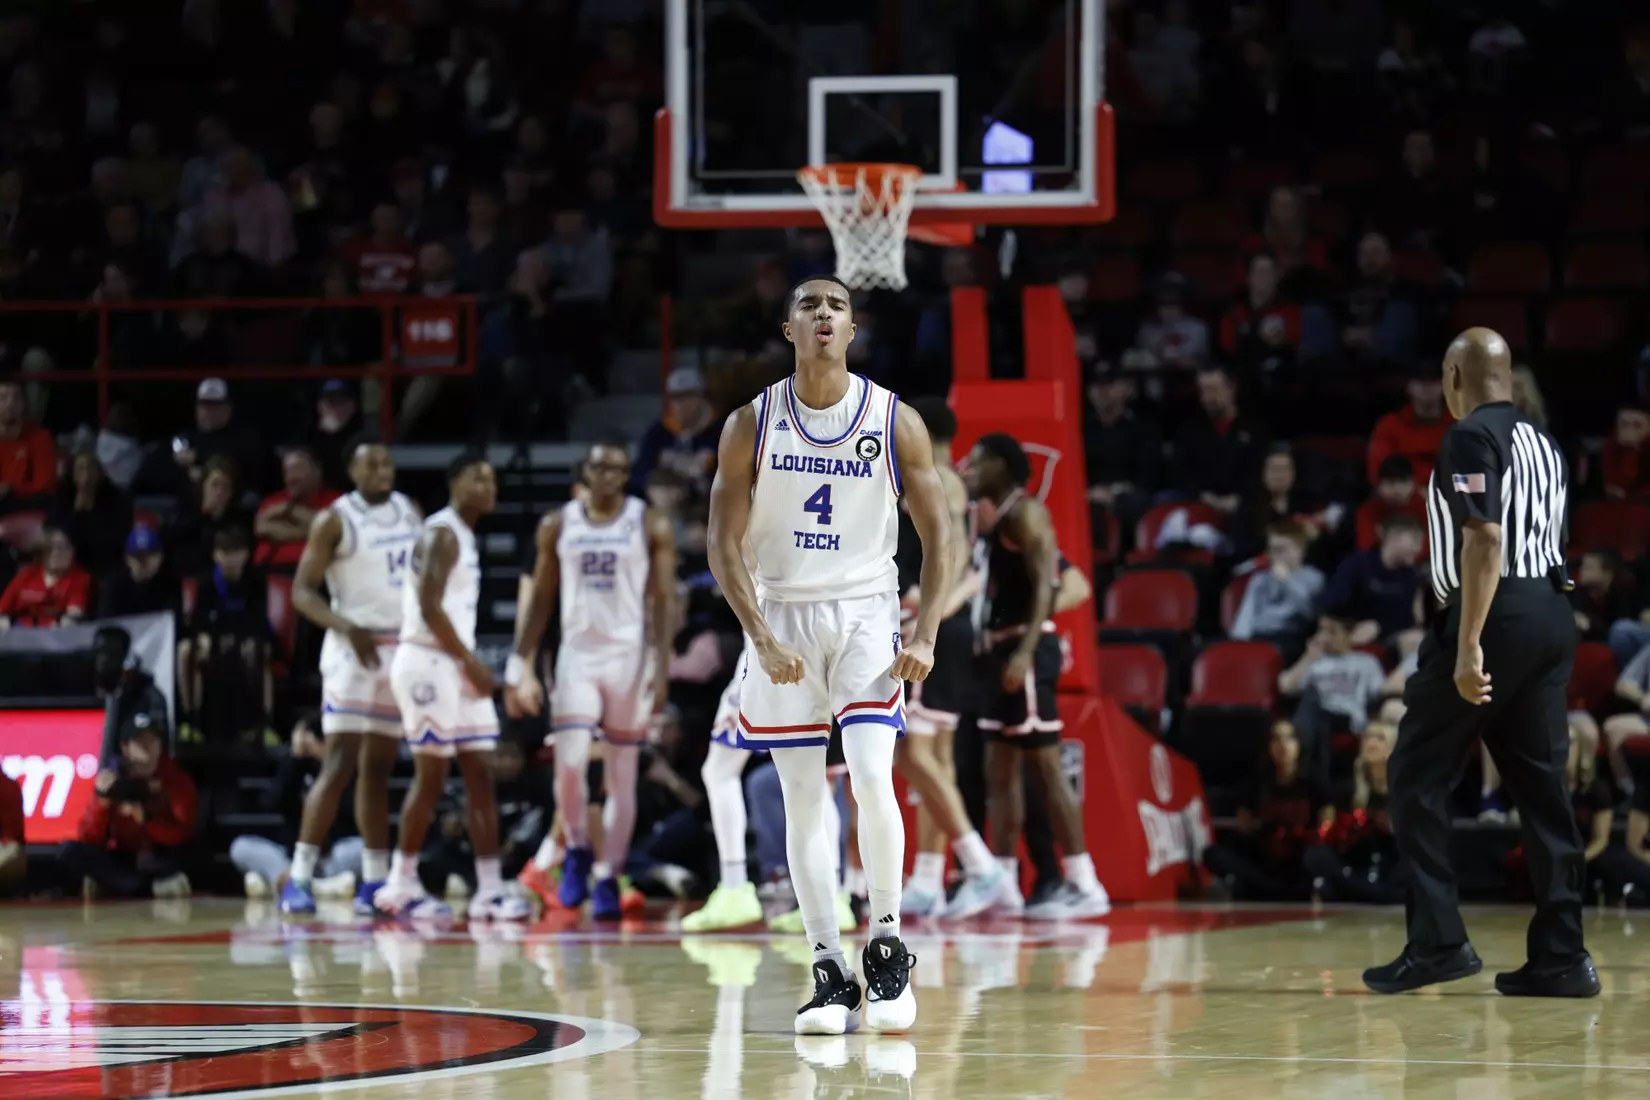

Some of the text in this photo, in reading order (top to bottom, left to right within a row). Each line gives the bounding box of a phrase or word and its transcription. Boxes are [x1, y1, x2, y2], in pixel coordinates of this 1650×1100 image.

[772, 454, 873, 478] LOUISIANA
[804, 484, 832, 525] 4
[794, 531, 840, 550] TECH
[581, 551, 616, 575] 22
